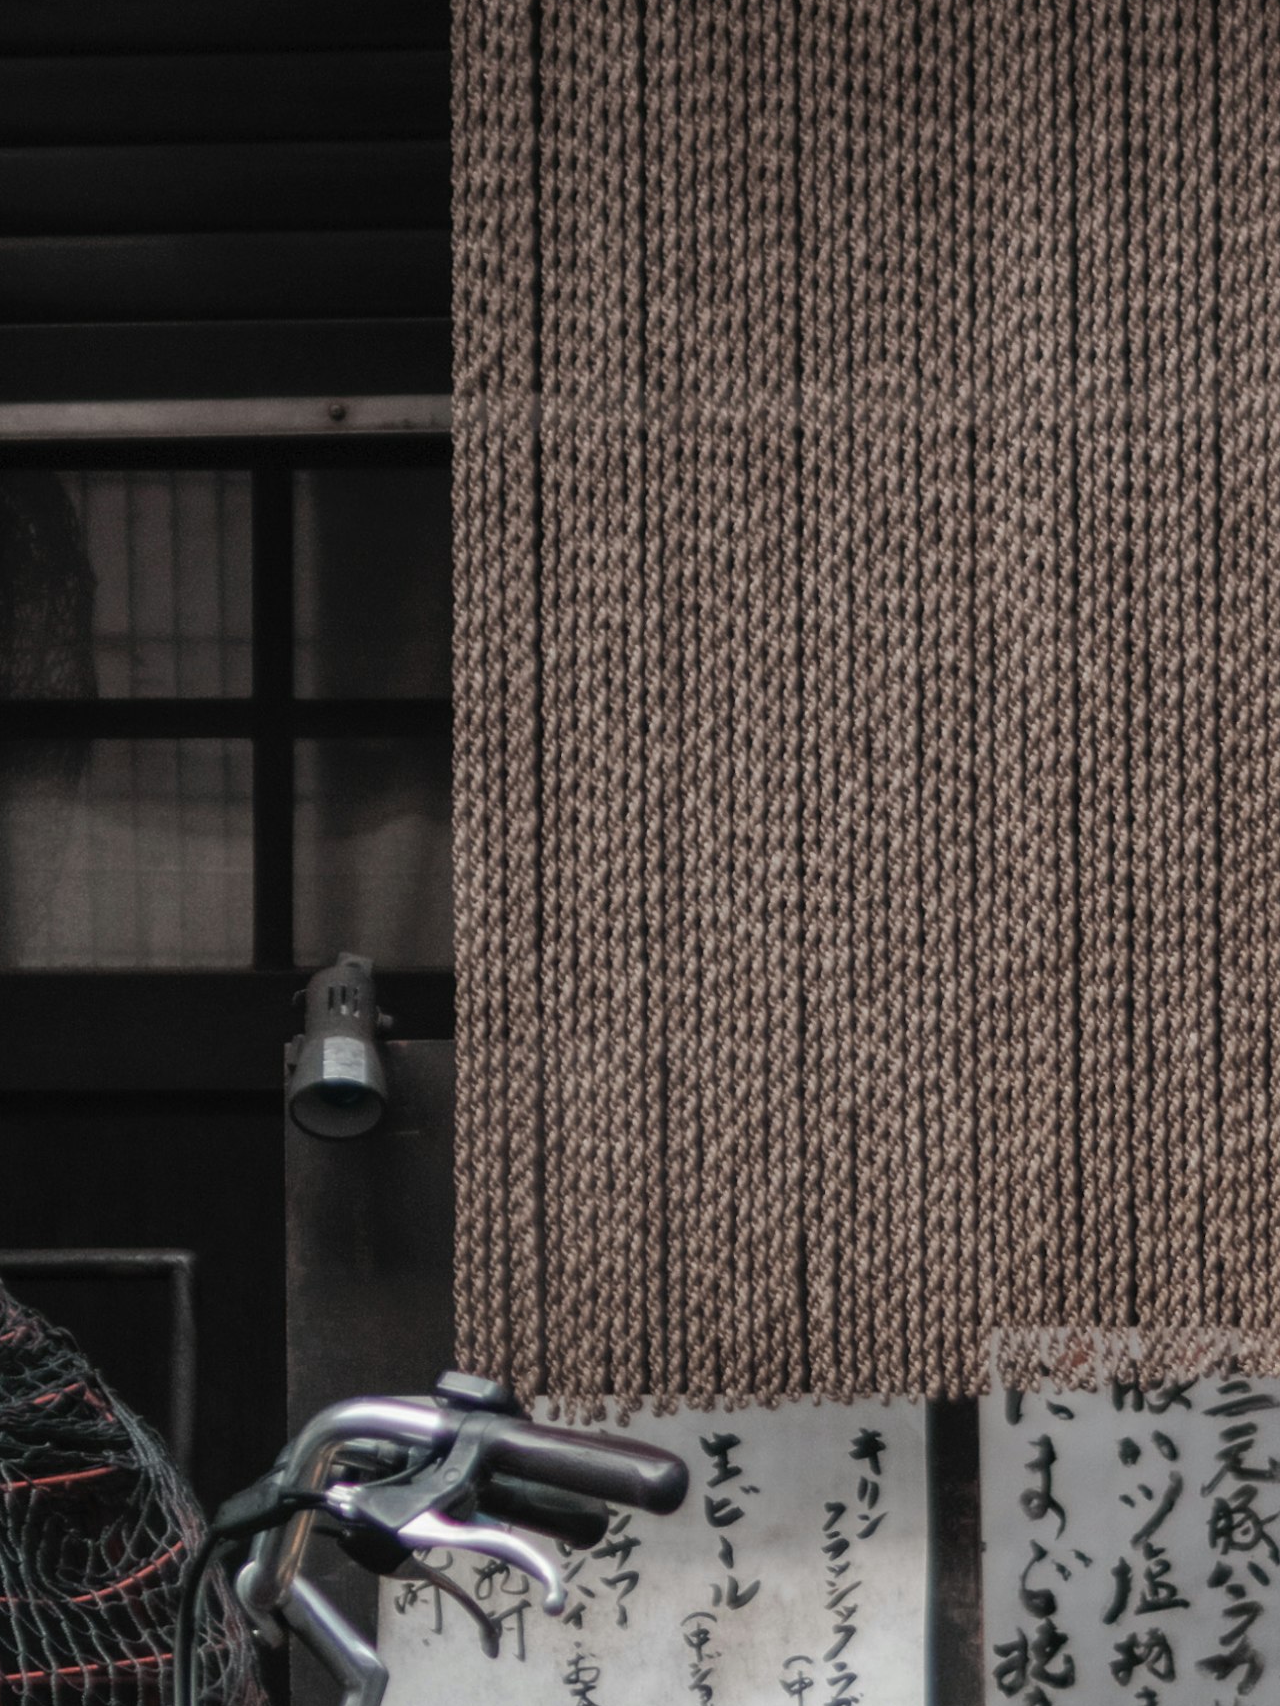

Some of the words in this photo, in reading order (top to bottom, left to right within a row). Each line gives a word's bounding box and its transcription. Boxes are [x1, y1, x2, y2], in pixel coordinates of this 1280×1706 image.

[699, 1431, 761, 1610] 生ビール
[849, 1427, 889, 1540] キリン
